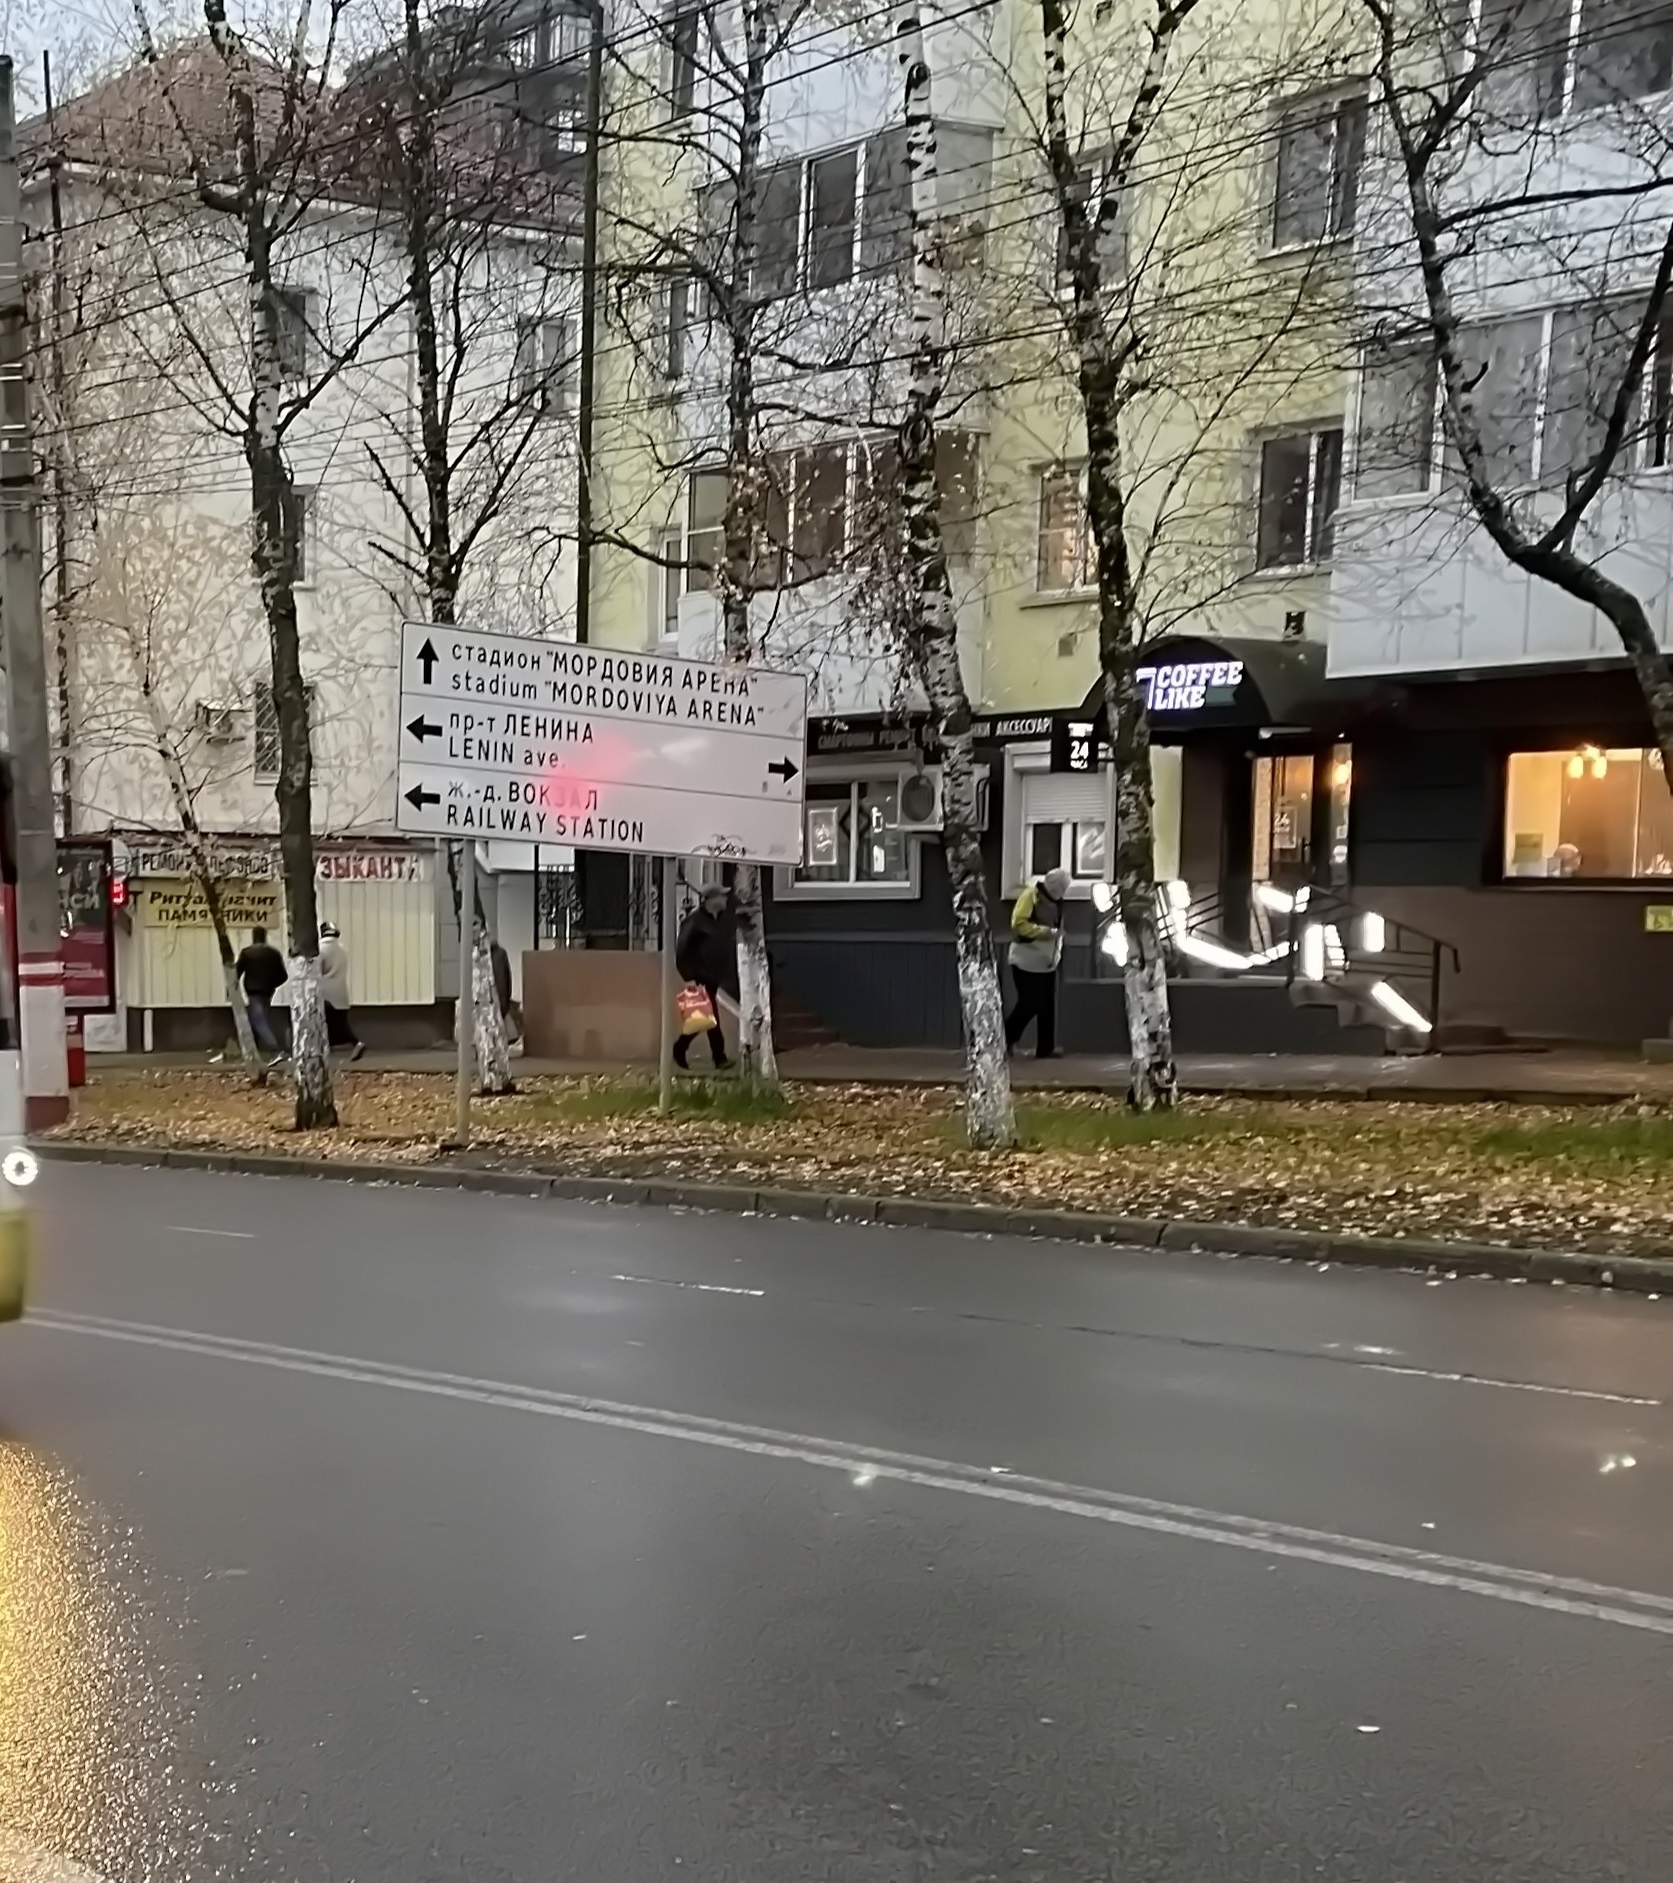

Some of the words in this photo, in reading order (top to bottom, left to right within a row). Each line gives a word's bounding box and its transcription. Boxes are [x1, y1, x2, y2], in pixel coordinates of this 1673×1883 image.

[451, 643, 541, 672] стадион
[546, 651, 673, 688] "МОРДОВИЯ
[681, 668, 758, 697] АРЕНА"
[1156, 661, 1244, 688] COFFEE
[451, 670, 537, 700] stadium
[545, 680, 677, 716] "MORDOVIYA
[687, 698, 764, 726] ARENA"
[1154, 685, 1206, 711] LIKE
[449, 713, 496, 735] пр-т
[504, 713, 594, 744] ЛЕНИНА
[449, 735, 514, 764] LENIN
[1069, 740, 1089, 760] 24
[446, 803, 547, 834] RAILWAY
[556, 814, 644, 843] STATION
